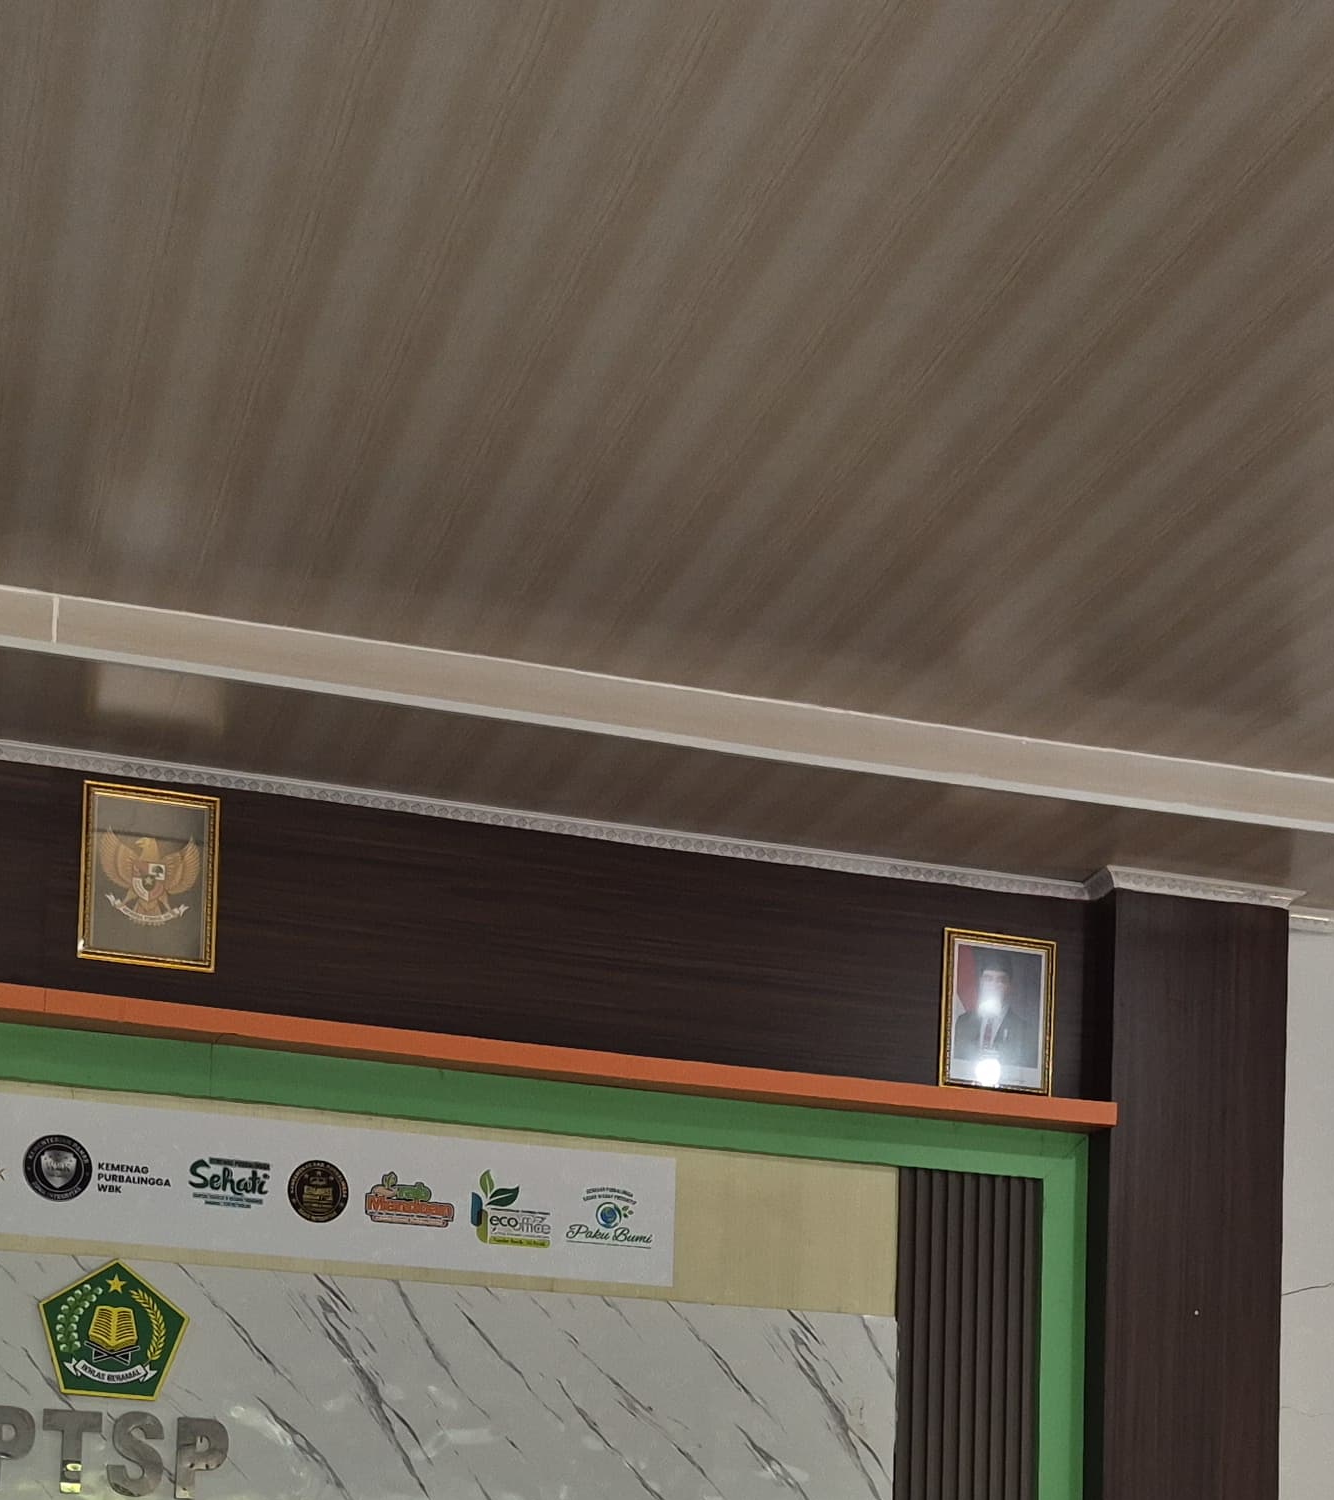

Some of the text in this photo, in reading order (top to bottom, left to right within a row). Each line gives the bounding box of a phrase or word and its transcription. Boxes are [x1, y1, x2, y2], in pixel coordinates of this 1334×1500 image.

[98, 1161, 150, 1175] KEMENAG
[97, 1173, 172, 1188] PURBALINGGA
[188, 1159, 271, 1196] Sehati
[97, 1183, 122, 1194] WBK
[566, 1223, 610, 1241] Paku
[612, 1226, 654, 1244] Bumi
